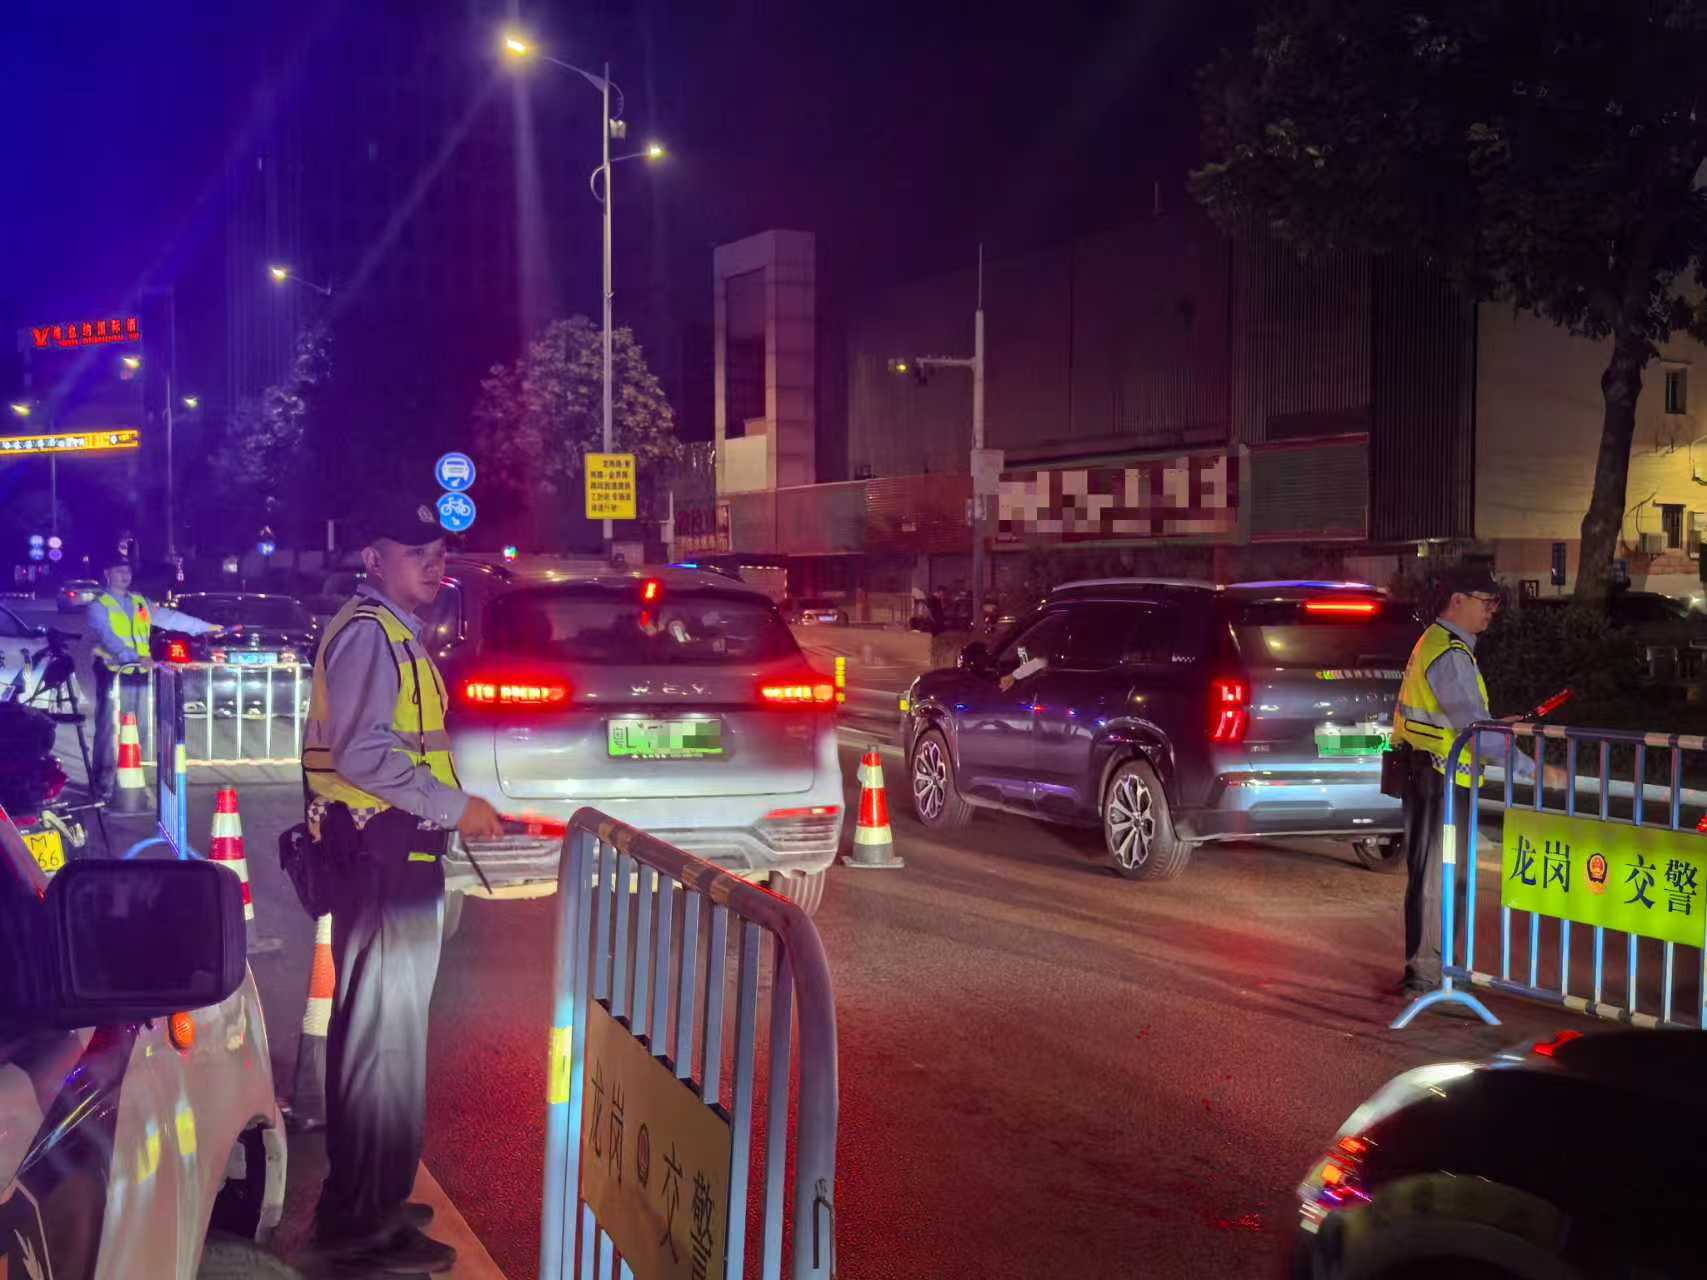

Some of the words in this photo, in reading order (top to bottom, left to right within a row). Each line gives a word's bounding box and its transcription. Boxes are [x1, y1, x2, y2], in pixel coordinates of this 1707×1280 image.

[1509, 835, 1572, 893] 龙岗
[1624, 854, 1698, 916] 交警
[589, 1058, 625, 1190] 龙岗
